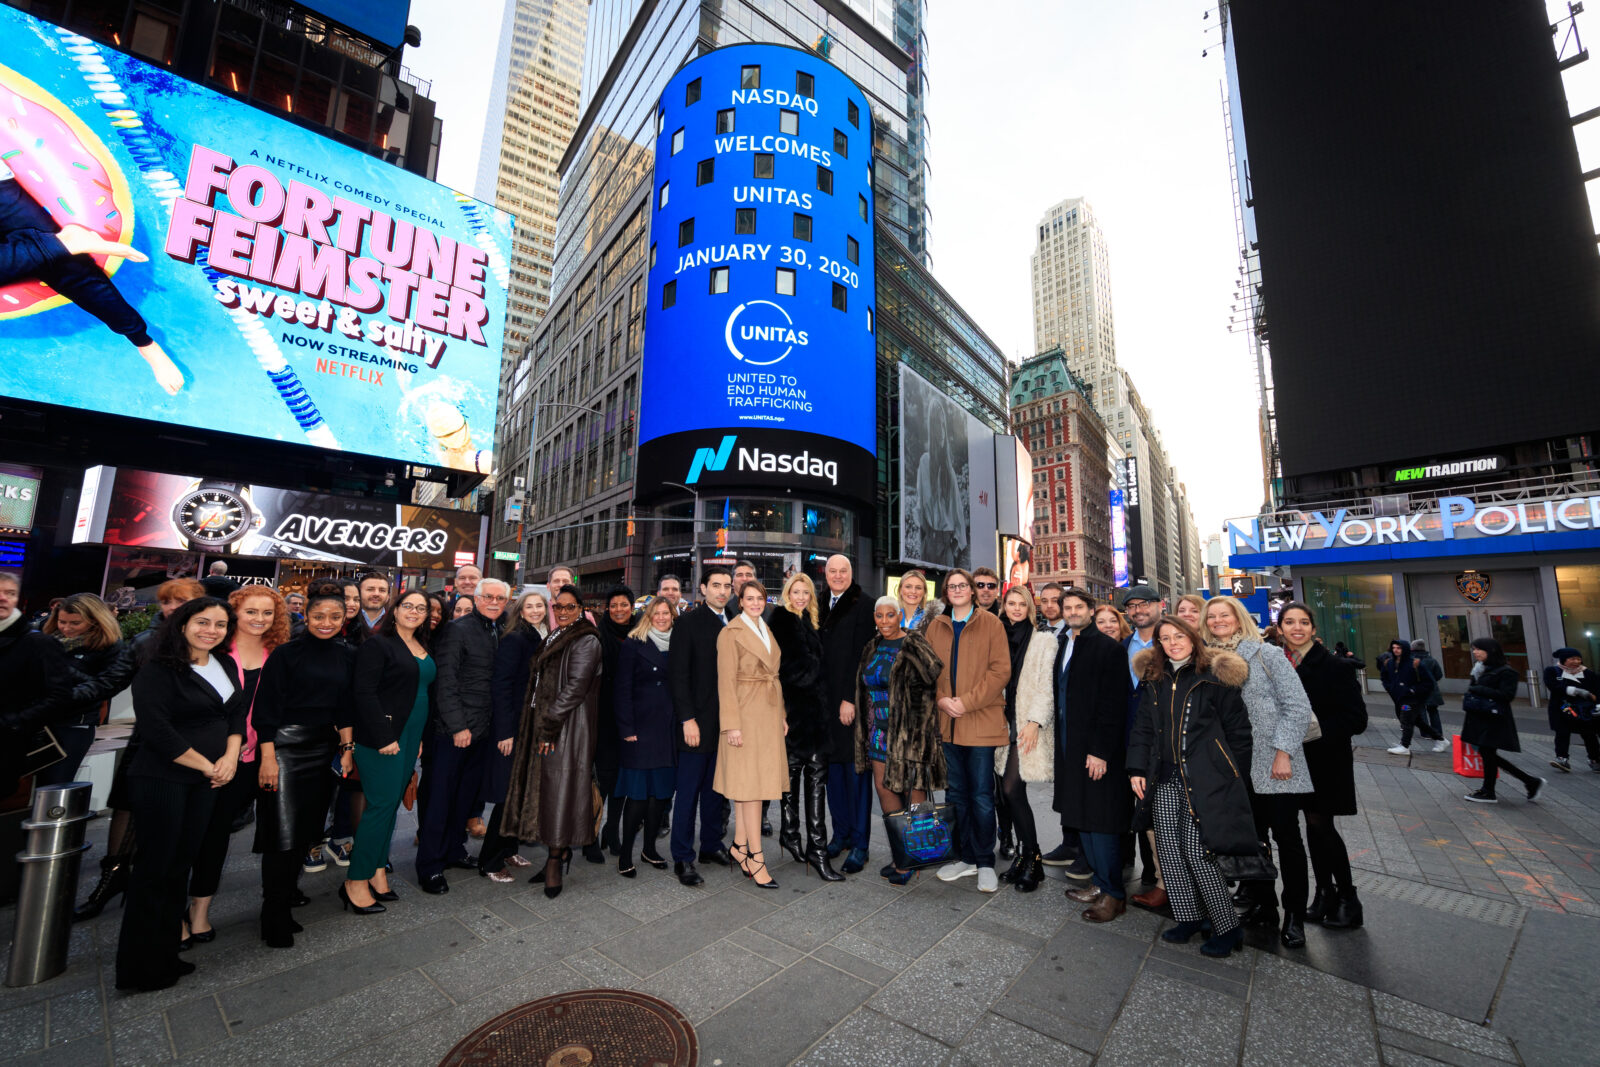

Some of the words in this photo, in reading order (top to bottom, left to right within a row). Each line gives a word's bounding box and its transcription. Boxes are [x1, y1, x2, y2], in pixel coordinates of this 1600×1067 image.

[731, 88, 819, 117] NASDAQ
[714, 135, 832, 167] WELCOMES
[249, 149, 260, 159] A
[265, 154, 329, 184] NETFLIX
[334, 181, 390, 208] COMEDY
[395, 203, 446, 229] SPECIAL
[733, 186, 813, 210] UNITAS
[184, 143, 488, 298] FORTUNE
[165, 197, 489, 347] FEIMSTER
[674, 243, 772, 274] JANUARY
[780, 245, 812, 270] 30,
[819, 255, 859, 289] 2020
[214, 278, 333, 332] sweet
[336, 307, 364, 341] &
[366, 317, 448, 368] salty
[740, 325, 809, 346] UNITAS
[282, 333, 324, 351] NOW
[327, 344, 419, 374] STREAMING
[316, 358, 384, 386] NETFLIX
[727, 373, 776, 385] UNITED
[780, 375, 797, 386] TO
[727, 384, 755, 395] END
[759, 385, 806, 399] HUMAN
[727, 396, 813, 413] TRAFFICKING
[738, 447, 838, 486] Nasdaq
[0, 484, 33, 501] KS
[274, 514, 449, 555] AVENGERS
[1228, 517, 1309, 555] NEW
[1311, 508, 1427, 548] YORK
[202, 574, 276, 588] TIZEN
